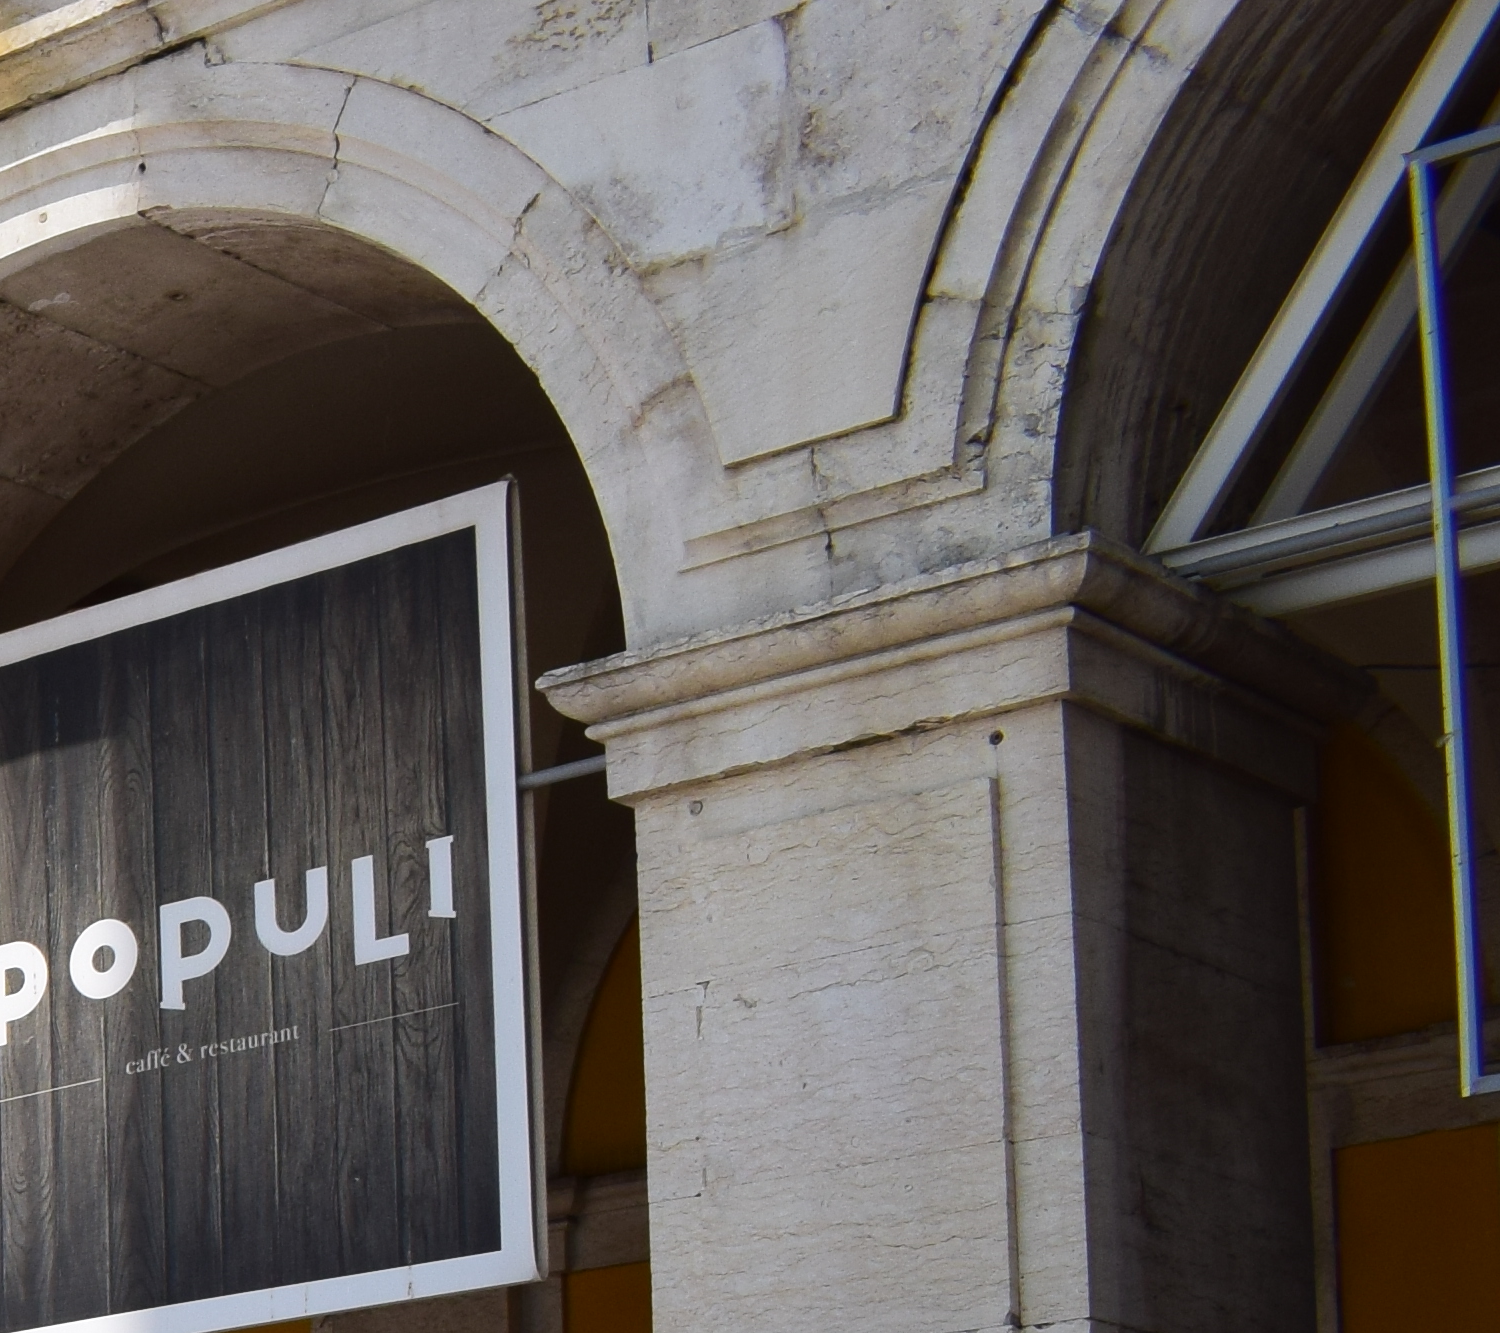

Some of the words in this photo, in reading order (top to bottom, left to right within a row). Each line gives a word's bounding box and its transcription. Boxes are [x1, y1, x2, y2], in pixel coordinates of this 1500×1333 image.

[125, 1046, 171, 1075] caffé
[176, 1043, 194, 1064] &
[200, 1025, 301, 1059] restaurant
